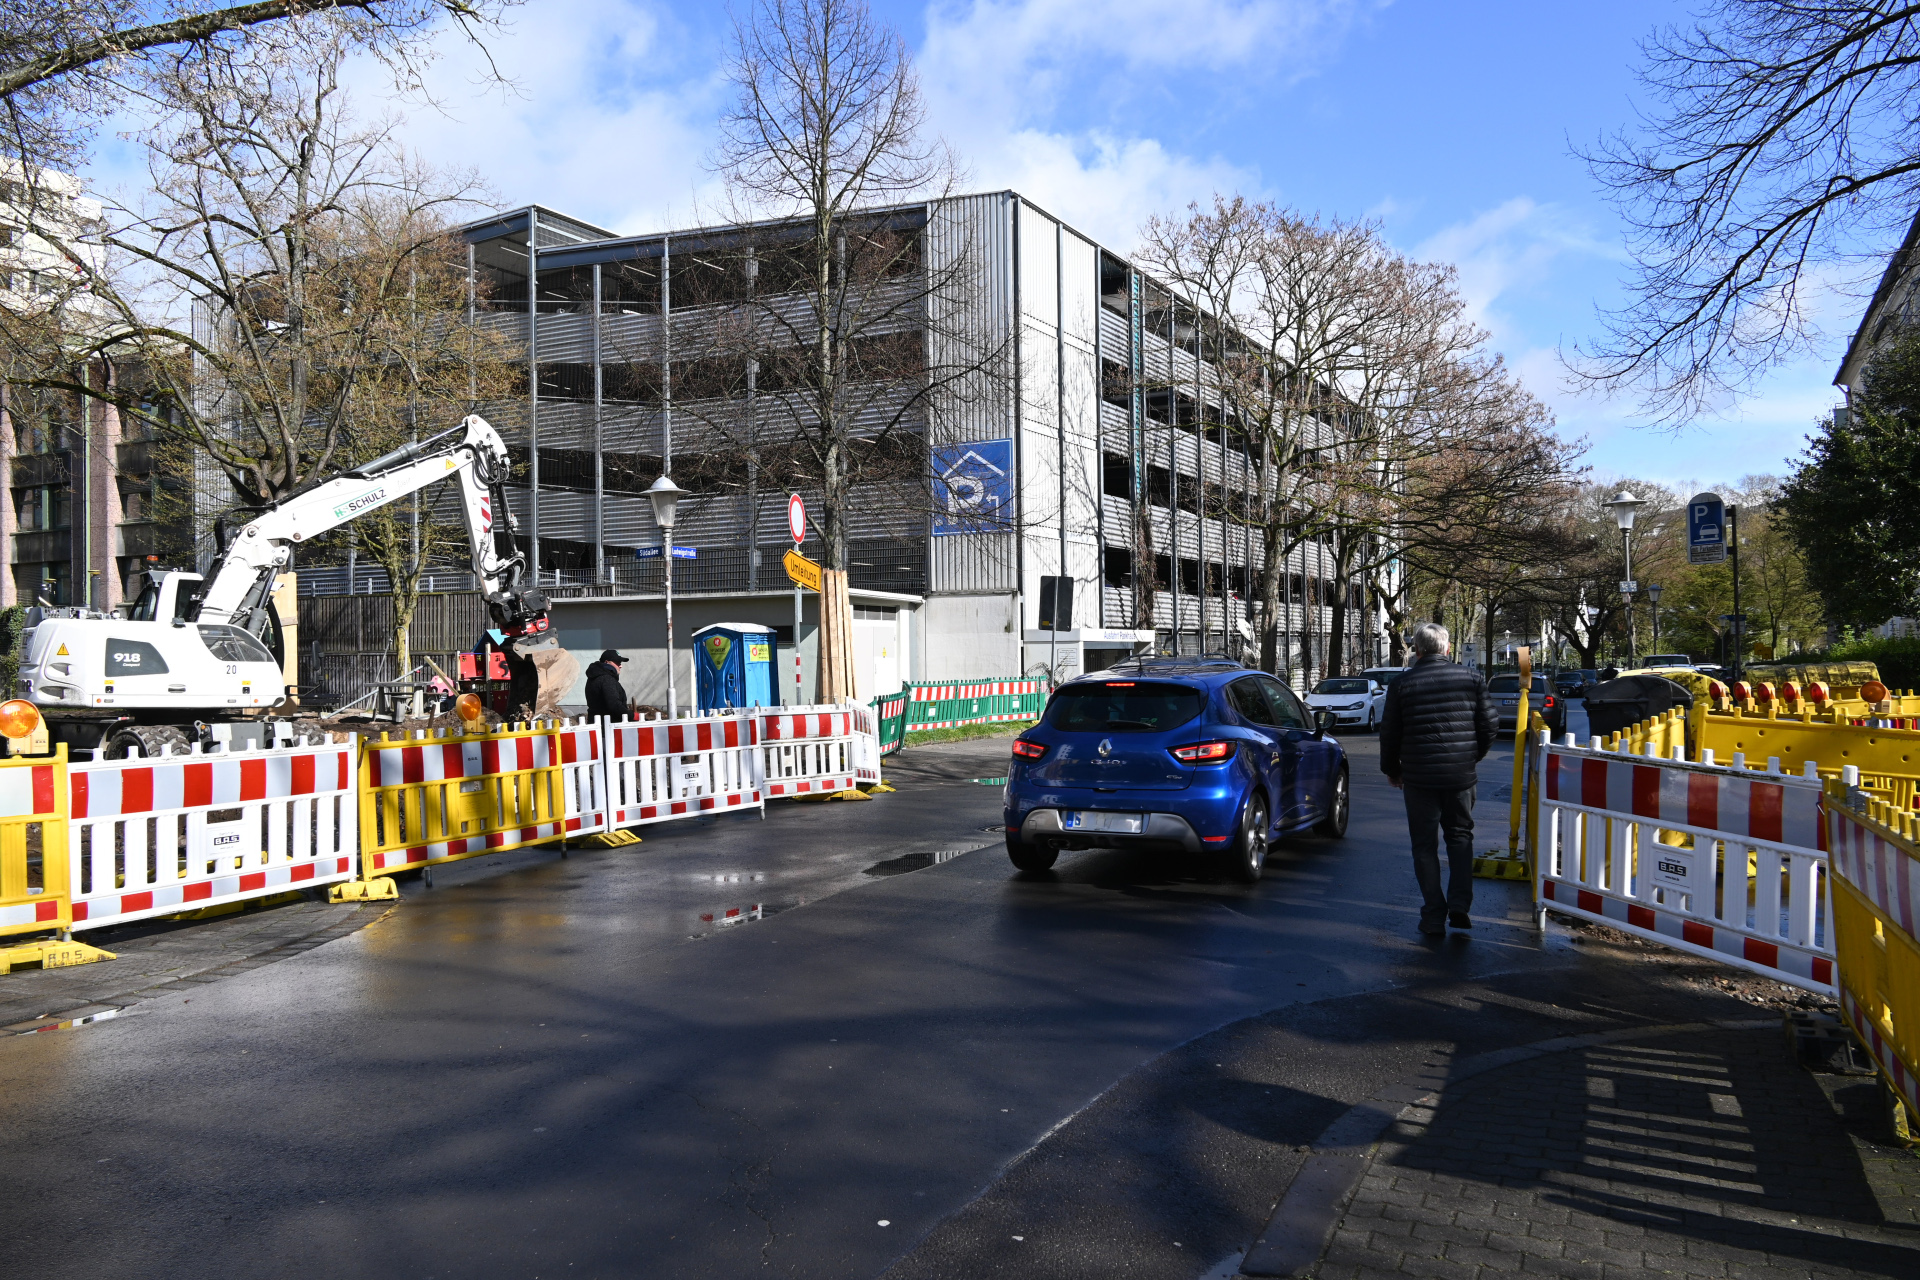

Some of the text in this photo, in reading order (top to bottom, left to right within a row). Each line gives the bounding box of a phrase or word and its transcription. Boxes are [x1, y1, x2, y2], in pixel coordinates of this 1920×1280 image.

[348, 489, 387, 511] SCHULZ
[1694, 505, 1708, 524] P
[790, 558, 817, 587] Umleitung
[113, 652, 141, 663] 918
[226, 664, 237, 675] 20
